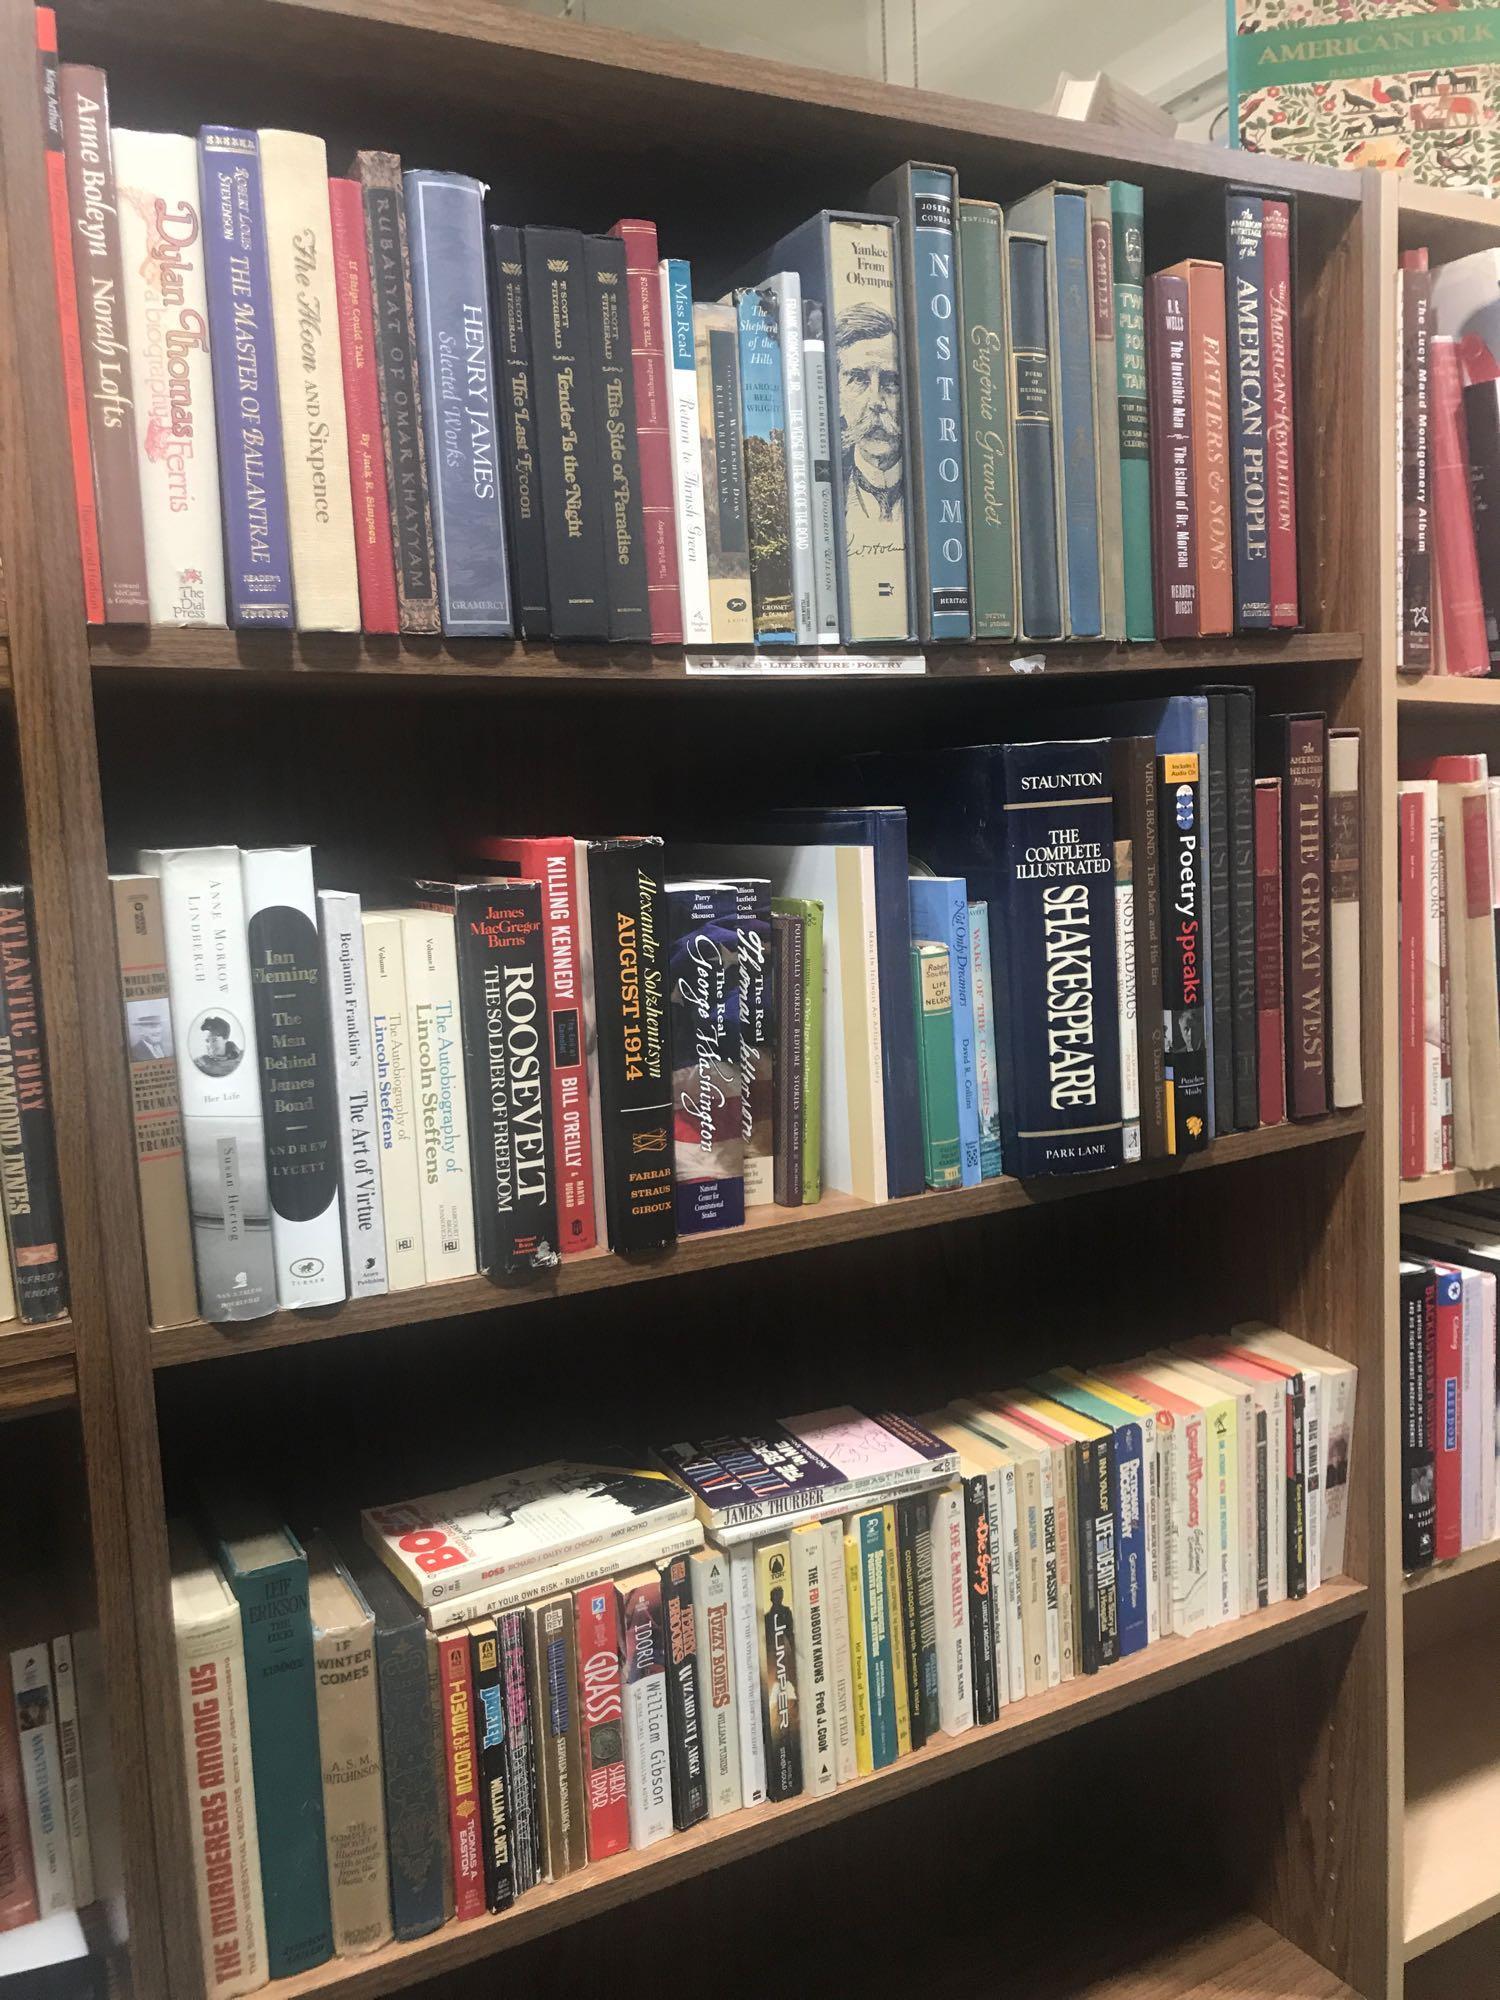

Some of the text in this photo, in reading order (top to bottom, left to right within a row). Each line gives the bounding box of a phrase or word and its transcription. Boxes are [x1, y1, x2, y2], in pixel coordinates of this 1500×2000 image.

[1258, 22, 1494, 65] AMERICAN FOLK
[78, 92, 117, 257] Anne Boleyn
[218, 172, 234, 240] STEVENSON
[845, 271, 894, 290] Olympus
[850, 242, 889, 258] Yankee
[857, 257, 886, 273] From
[1097, 238, 1110, 319] CAMILLE
[91, 276, 134, 429] Norah Lofts
[152, 198, 209, 437] Dylan Thomas
[675, 282, 692, 358] Miss Read
[230, 255, 270, 564] THE MASTER OF BALLANTRAE
[377, 199, 425, 597] RUBAIYAT OMAR KHAYYAM
[438, 331, 464, 468] Selected Works
[463, 303, 494, 500] HENRY JAMES
[1171, 361, 1187, 404] Invisible
[1237, 276, 1267, 561] AMERICAN PEOPLE
[1202, 334, 1227, 572] FATHERS SONS
[1415, 299, 1429, 552] The Lucy Maud Montgomery Album
[168, 440, 195, 513] Ferris
[305, 421, 330, 523] Sixpence
[515, 452, 533, 520] Tycoon
[606, 418, 632, 567] Side Paradise
[976, 430, 1006, 527] Grandet
[567, 484, 583, 539] Night
[1175, 467, 1191, 569] Island Moreau
[768, 660, 904, 670] LITERATURE POETRY
[1020, 772, 1103, 791] STAUNTON
[1024, 843, 1102, 864] COMPLETE
[1048, 828, 1081, 845] THE
[1300, 794, 1321, 864] THE
[547, 856, 570, 920] KILLING
[1015, 858, 1112, 880] ILLUSTRATED
[1429, 816, 1441, 920] THE UNICORN
[470, 921, 542, 937] MacGregor
[485, 906, 525, 921] James
[487, 935, 526, 949] Burns
[1175, 835, 1201, 1004] Poetry Speaks
[1300, 872, 1323, 977] GREAT
[264, 950, 296, 966] Ian
[551, 925, 574, 999] KENNEDY
[638, 868, 665, 1079] Alexander Solzhenitsyn
[736, 928, 766, 1024] Thomas
[0, 906, 46, 1111] ATLANTIC FURY
[272, 1012, 303, 1027] The
[616, 911, 644, 1081] AUGUST 1914
[716, 968, 727, 1038] The Real
[754, 975, 765, 1042] The Real
[1041, 883, 1098, 1111] SHAKESPEARE
[1302, 982, 1325, 1076] WEST
[265, 1054, 318, 1070] Behind
[271, 1034, 307, 1049] Man
[678, 934, 734, 1153] George Washington
[269, 1078, 316, 1093] James
[275, 1096, 316, 1113] Bond
[339, 932, 377, 1232] Benjamin Franklin's The Art of Virtue
[373, 1015, 396, 1150] Lincoln Steffens
[389, 1039, 411, 1127] Autobiography
[415, 1003, 442, 1185] Lincoln Steffens
[435, 1001, 462, 1157] The Autobiography
[484, 964, 513, 1214] THE SOLDIER OF FREEDOM
[503, 962, 548, 1207] ROOSEVELT
[561, 1076, 579, 1108] BILL
[965, 1079, 974, 1110] Collins
[564, 1111, 582, 1167] O'REILLY
[628, 1167, 672, 1182] FARRAR
[1045, 1144, 1107, 1160] PARK LANE
[222, 1145, 241, 1242] Susan Hertog
[722, 1499, 764, 1526] JAMES
[766, 1488, 825, 1516] THURBER
[1098, 1457, 1109, 1512] INA YALOF
[1120, 1461, 1133, 1540] BIOGRAPHY
[973, 1552, 992, 1596] Song
[989, 1509, 1001, 1577] LIVE TO FLY
[1045, 1506, 1059, 1612] FISCHER SPASSKY
[1095, 1513, 1115, 1589] LIFE DEATH
[486, 1573, 586, 1612] AT YOUR OWN RISK Ralph
[951, 1522, 964, 1671] JOE MARILYN ROGER
[317, 1650, 371, 1670] WINTER
[320, 1666, 369, 1686] COMES
[634, 1620, 655, 1669] IDORU
[707, 1603, 731, 1710] FUZZY BONES
[773, 1613, 790, 1730] JUMPER
[808, 1566, 830, 1754] THE FBI NOBODY KNOWS Fred Cook
[584, 1650, 622, 1723] GRASS
[645, 1681, 664, 1744] William
[590, 1766, 609, 1810] TEPPER
[648, 1749, 667, 1806] Gibson
[189, 1662, 242, 1985] THE MURDERERS AMONG US
